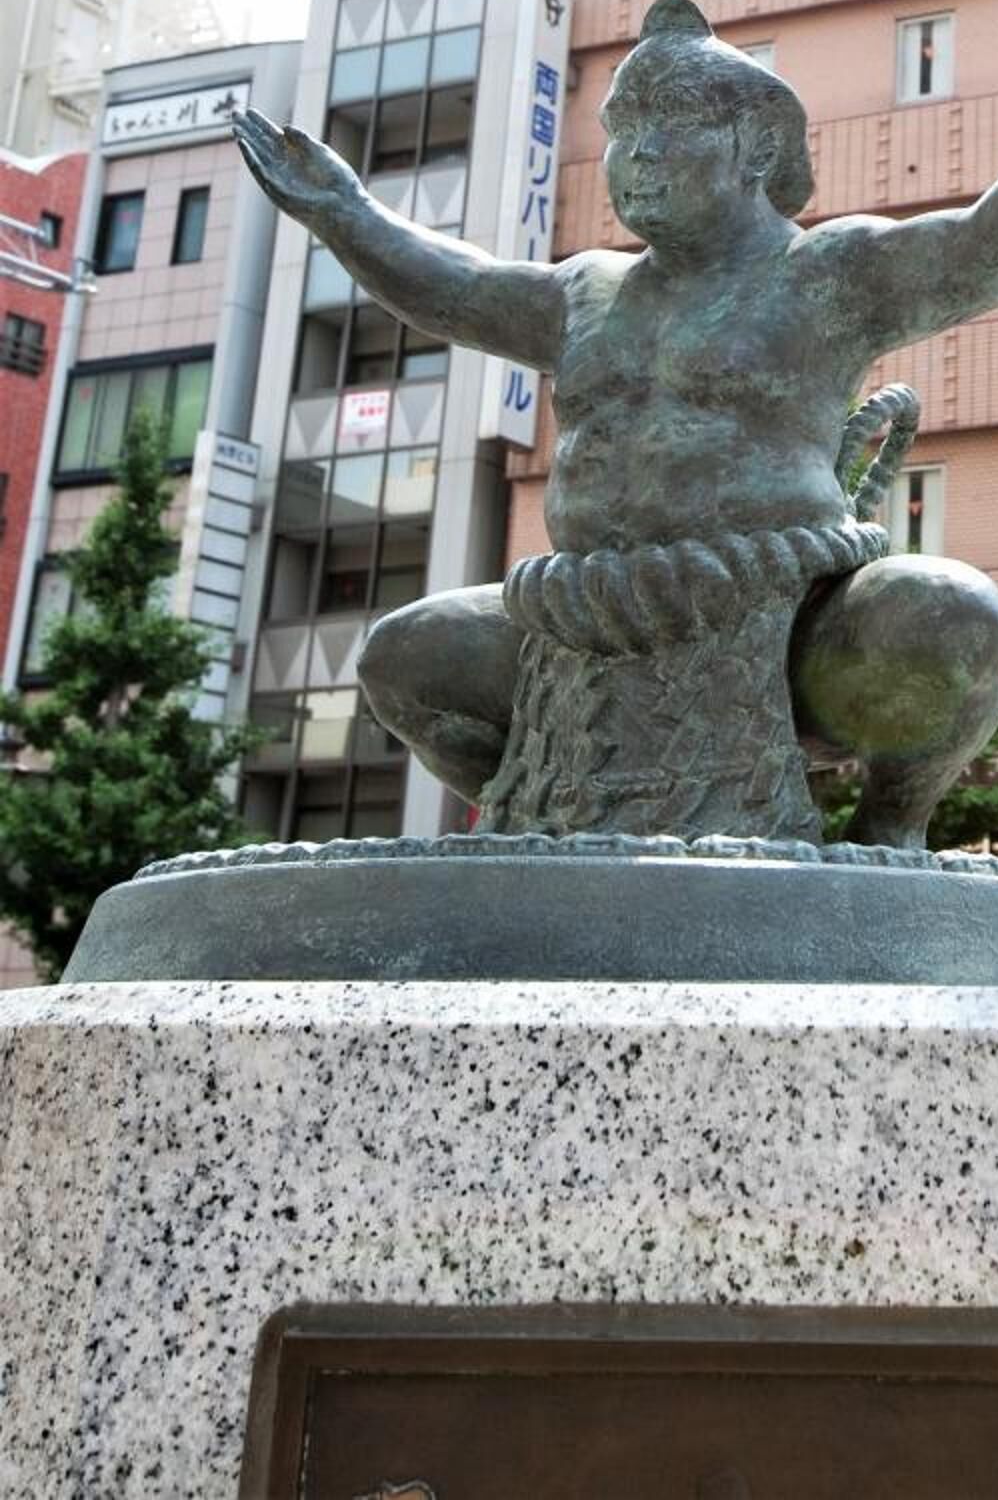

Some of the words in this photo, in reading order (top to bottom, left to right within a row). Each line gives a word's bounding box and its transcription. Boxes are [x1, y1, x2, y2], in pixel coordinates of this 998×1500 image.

[504, 61, 560, 412] 両国リバール
